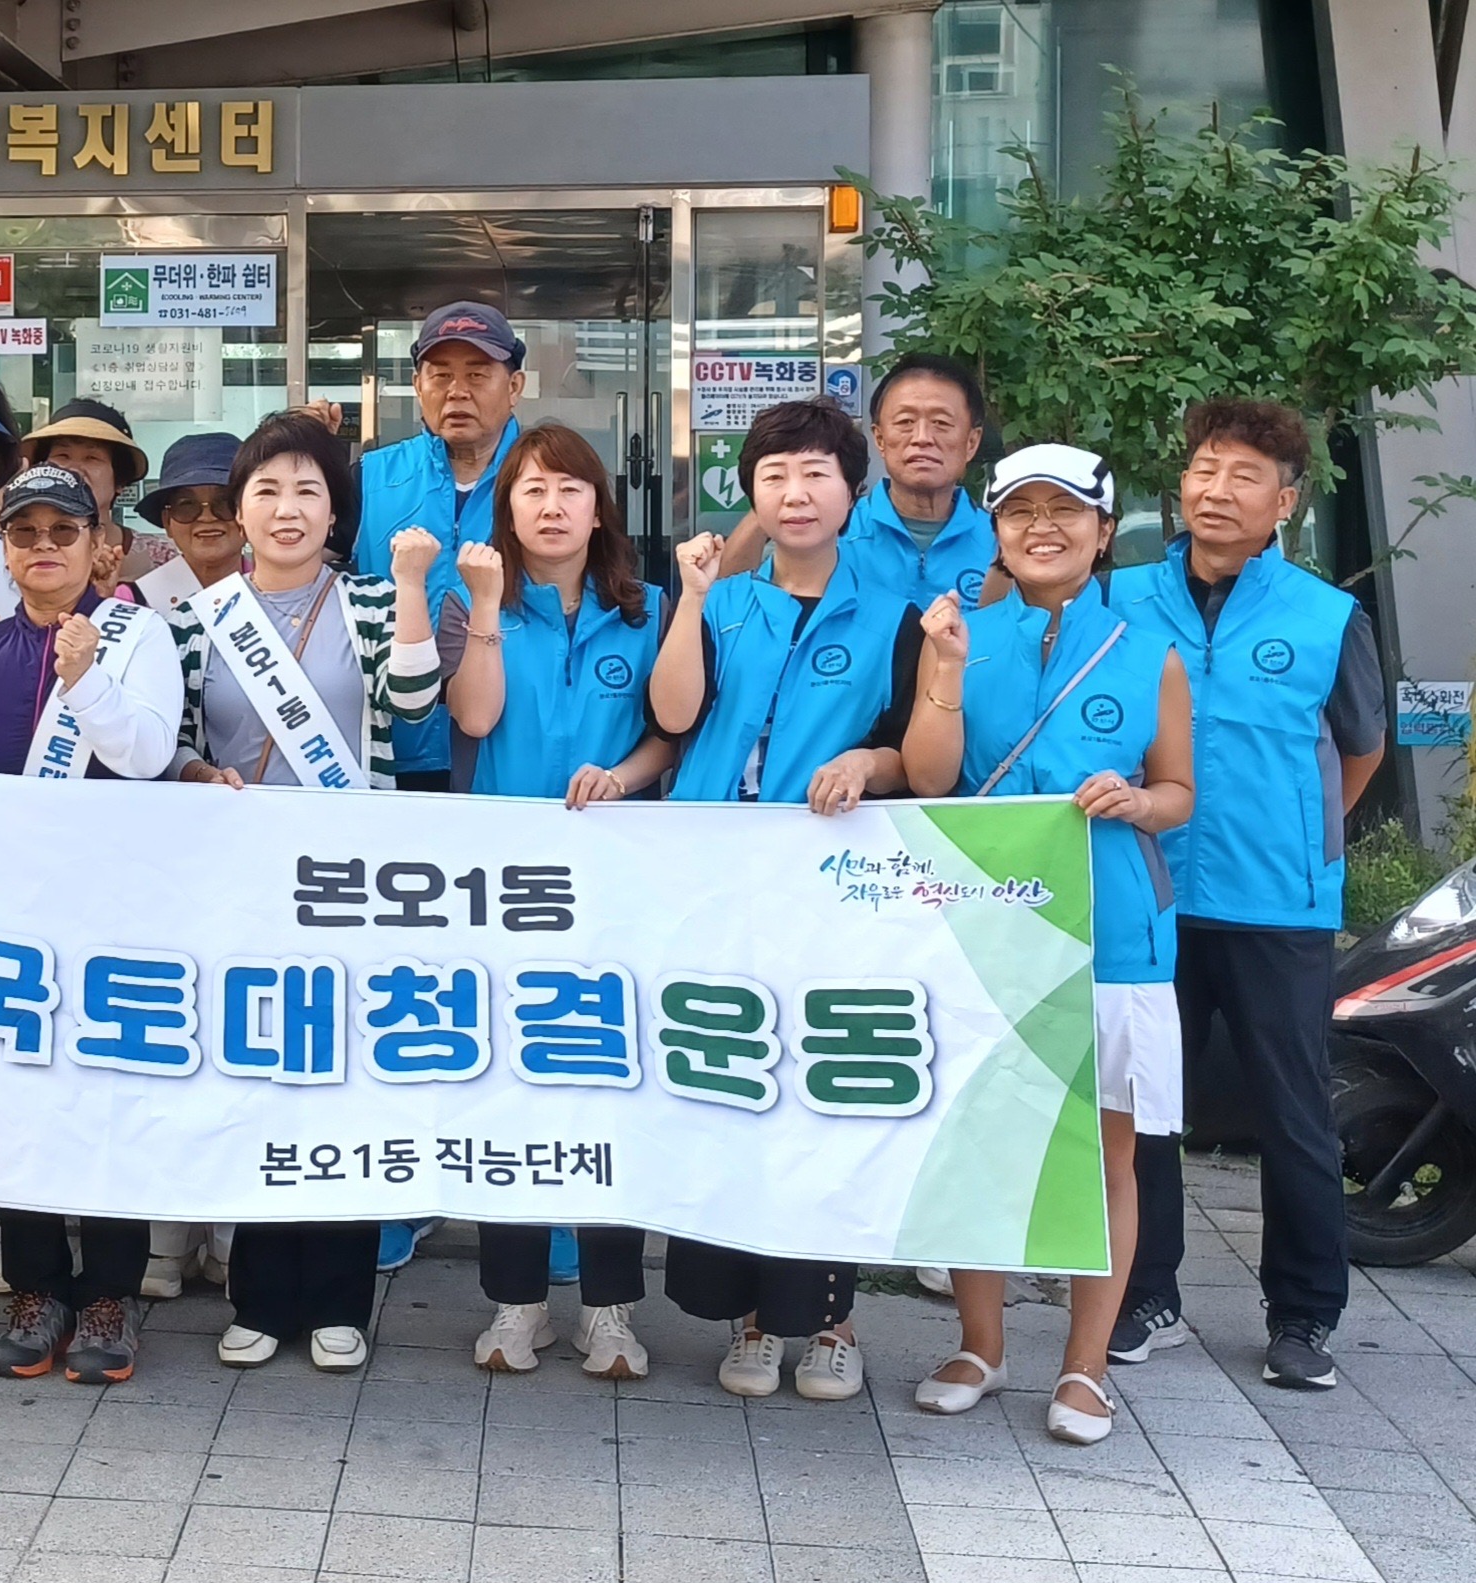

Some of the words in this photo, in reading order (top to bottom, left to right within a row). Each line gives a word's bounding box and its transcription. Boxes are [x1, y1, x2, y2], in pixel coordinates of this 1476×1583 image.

[242, 263, 271, 289] 쉼터
[11, 327, 43, 345] 녹화중
[90, 342, 140, 355] 코로나19
[90, 380, 137, 392] 신청안내
[228, 620, 312, 731] 본오1동
[819, 849, 887, 886] 시민과
[293, 855, 577, 932] 본오1동
[840, 883, 905, 913] 자유로운
[912, 880, 985, 910] 혁신도시
[991, 879, 1052, 905] 안산
[259, 1138, 421, 1187] 본오1동
[435, 1137, 614, 1187] 직능단체
